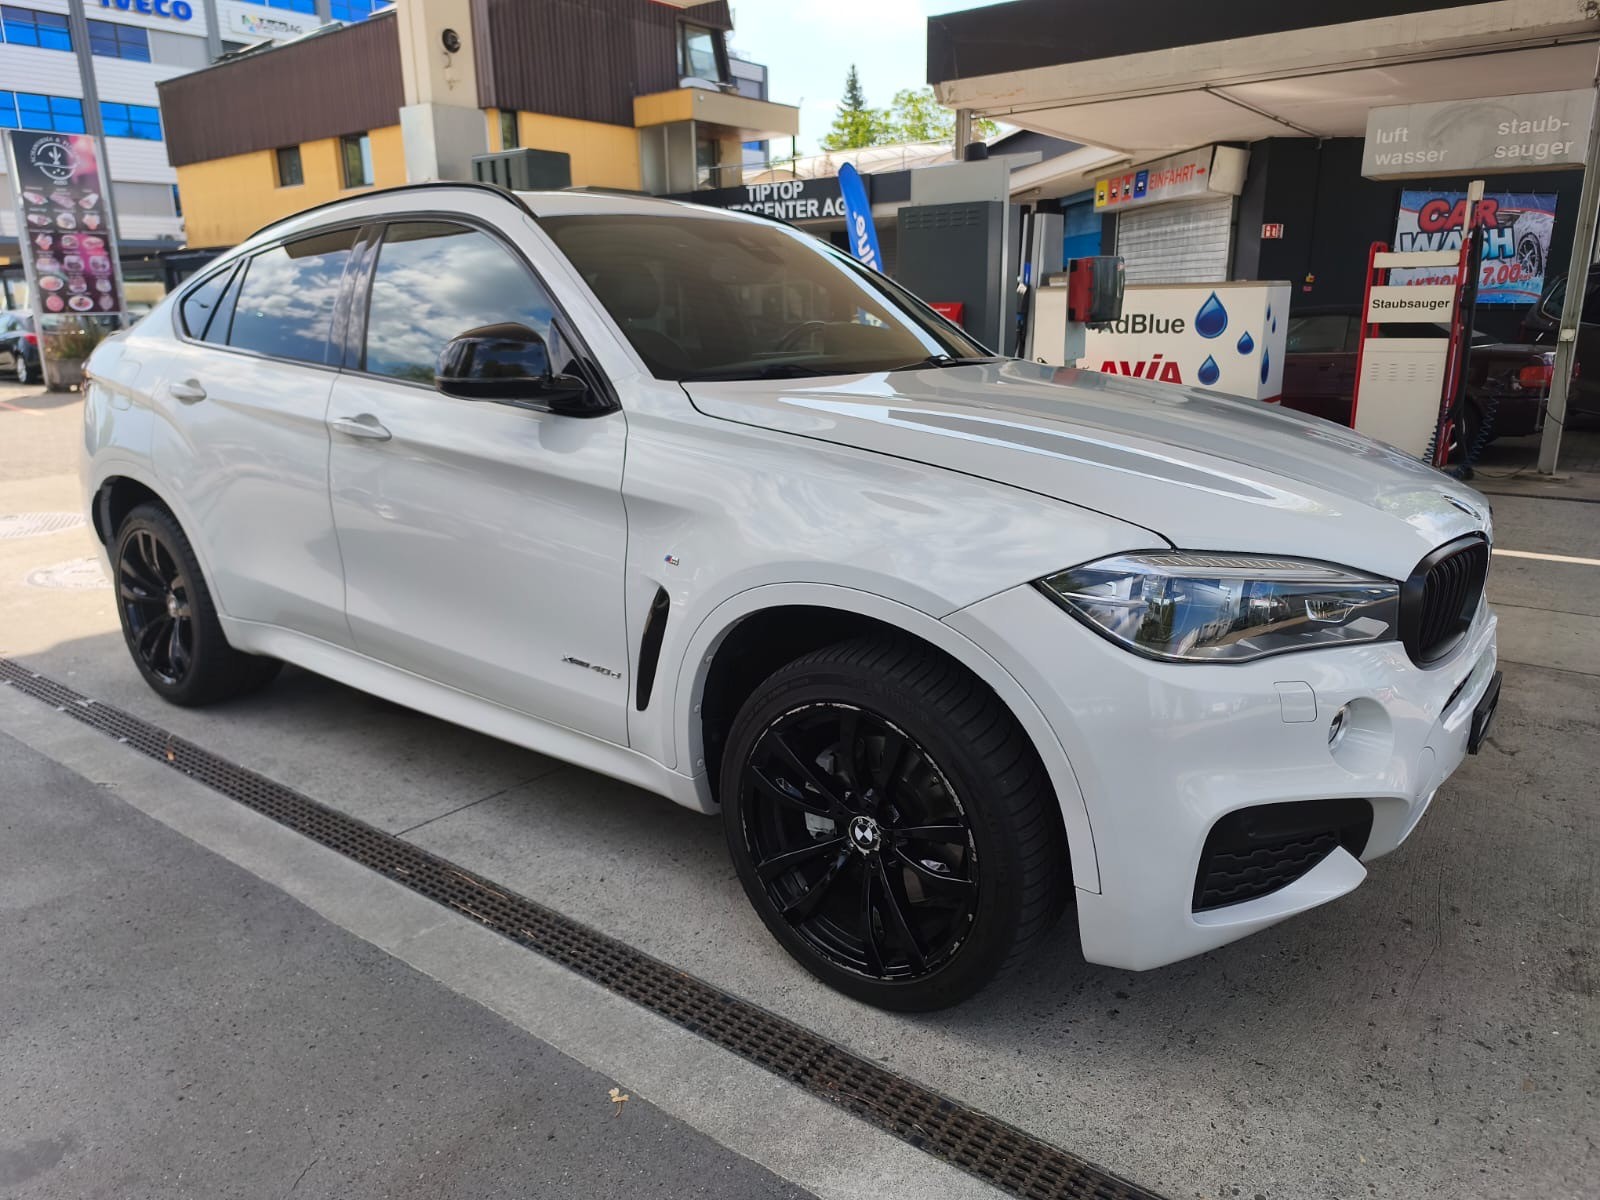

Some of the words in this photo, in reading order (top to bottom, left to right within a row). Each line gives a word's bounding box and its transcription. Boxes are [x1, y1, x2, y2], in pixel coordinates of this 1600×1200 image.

[1376, 127, 1409, 145] luft
[1497, 115, 1570, 136] staub-
[1375, 148, 1448, 166] wasser
[1494, 141, 1575, 160] sauger
[1149, 164, 1196, 190] EINFAHRT
[746, 181, 804, 202] TIPTOP
[822, 197, 847, 217] AG
[1418, 198, 1499, 233] CAR
[1400, 226, 1516, 260] WAH
[1482, 263, 1521, 286] 7.00
[1372, 299, 1451, 310] Staubsauger
